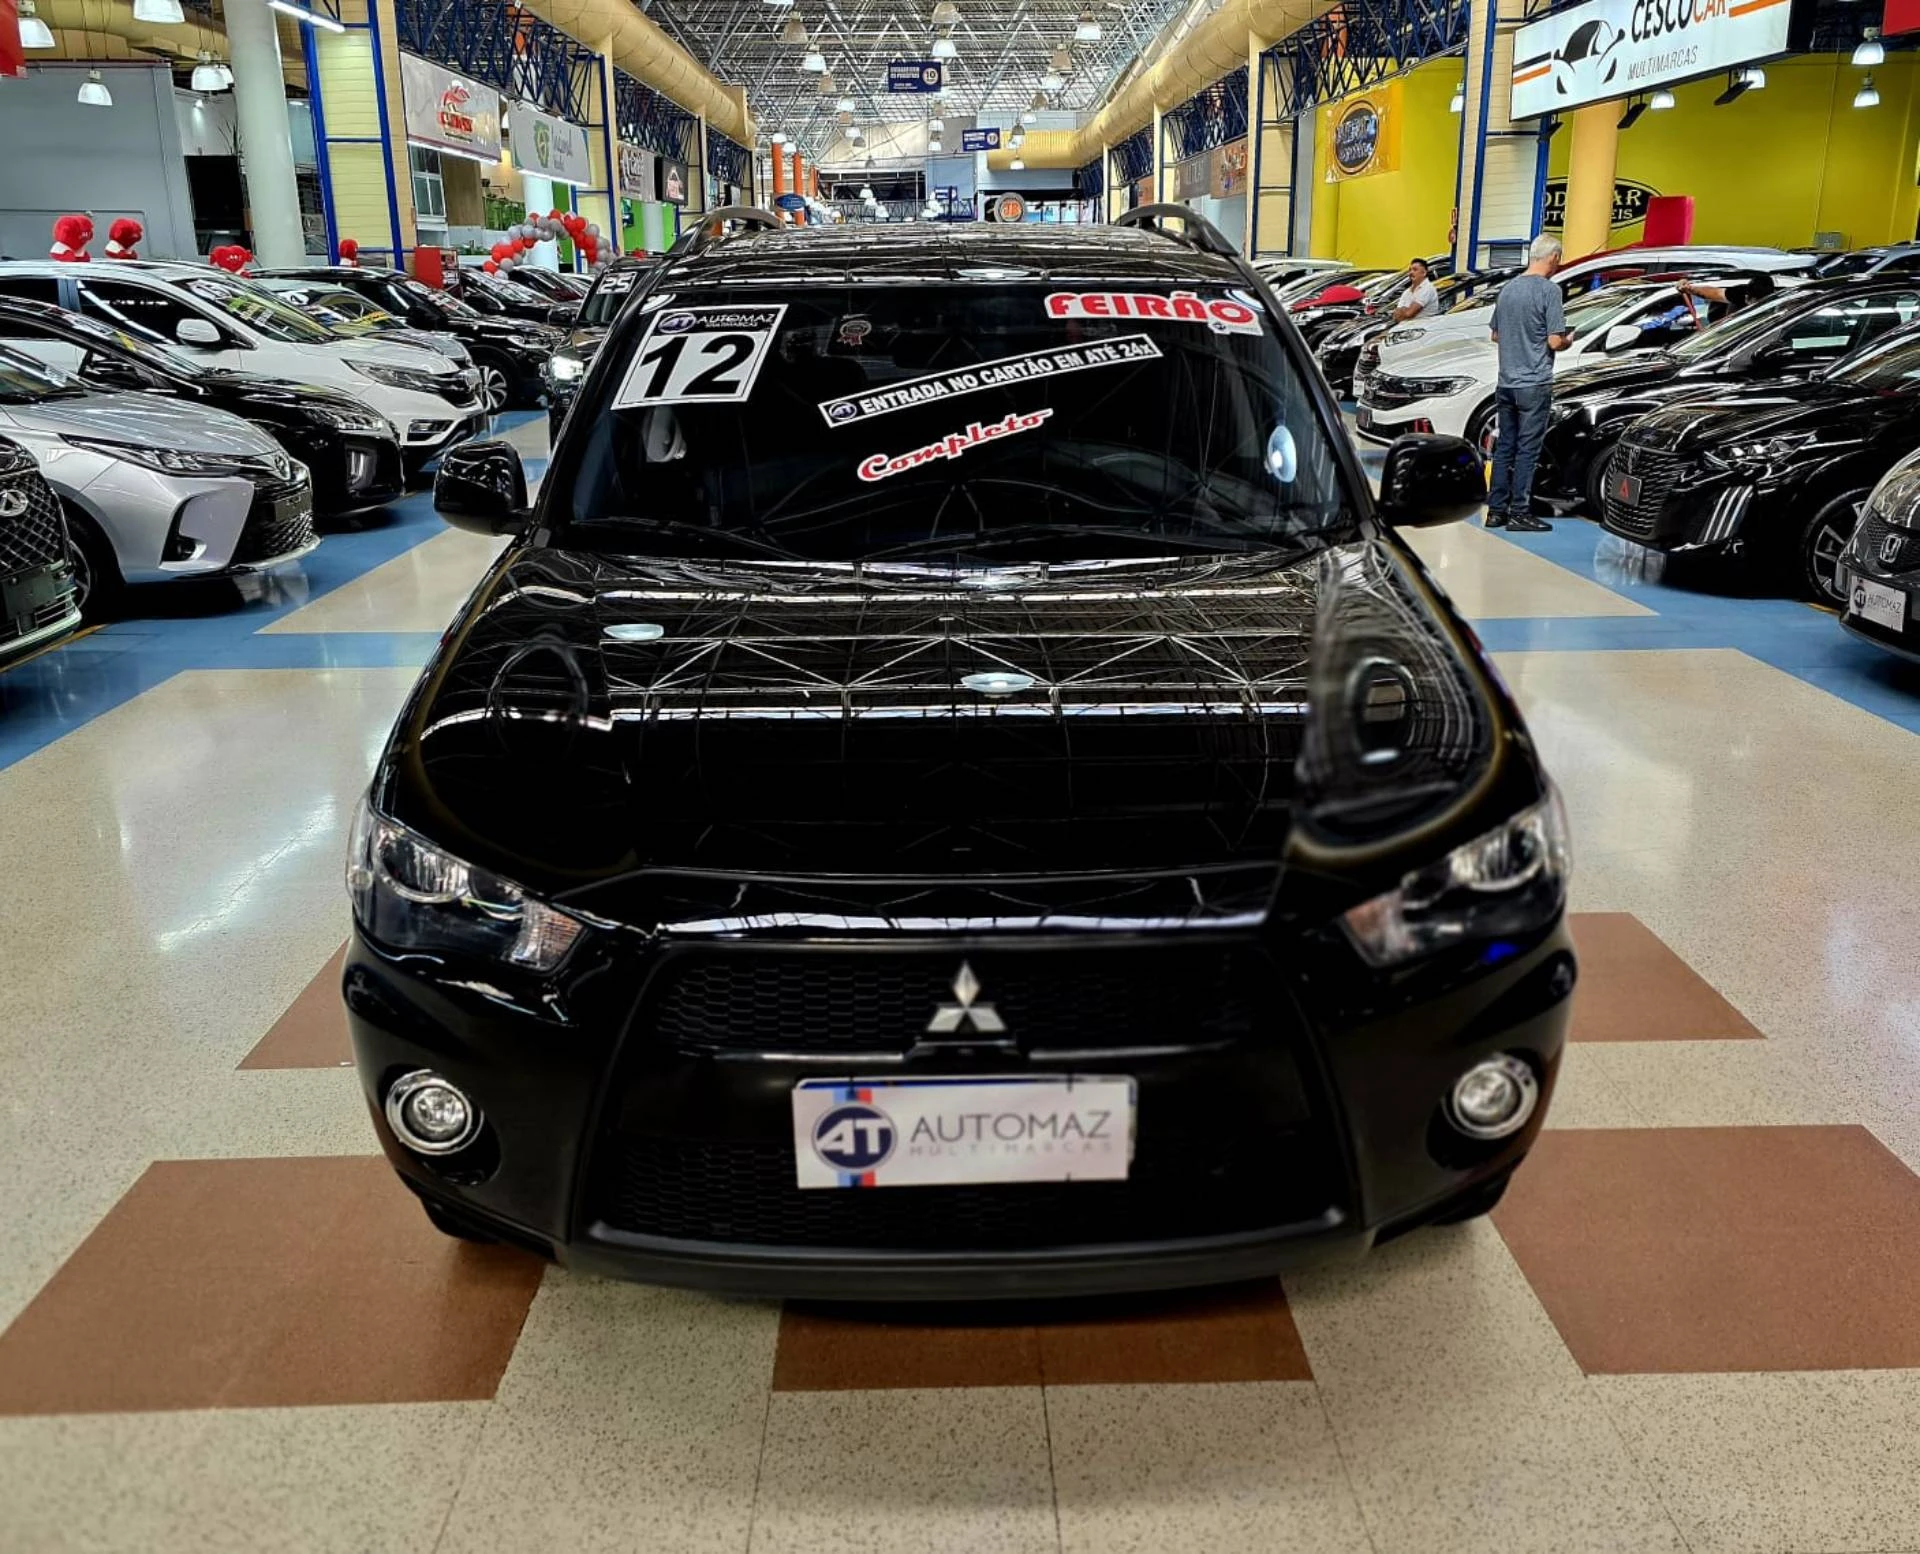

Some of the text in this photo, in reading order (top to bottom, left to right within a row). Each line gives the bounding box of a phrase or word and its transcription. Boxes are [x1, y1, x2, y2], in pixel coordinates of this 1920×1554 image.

[1627, 44, 1699, 81] MULTIMARCAS
[697, 313, 776, 324] AUTOMAZ
[1050, 292, 1254, 324] FEIRÃO
[640, 334, 756, 399] 12
[859, 381, 950, 414] ENTRADA
[948, 374, 978, 392] NO
[979, 357, 1054, 384] CARTÃO
[1053, 352, 1085, 370] EM
[1085, 343, 1121, 364] ATÉ
[1119, 342, 1154, 358] 24x
[859, 409, 1053, 480] Completo
[816, 1111, 1112, 1155] AT AUTOMAZ
